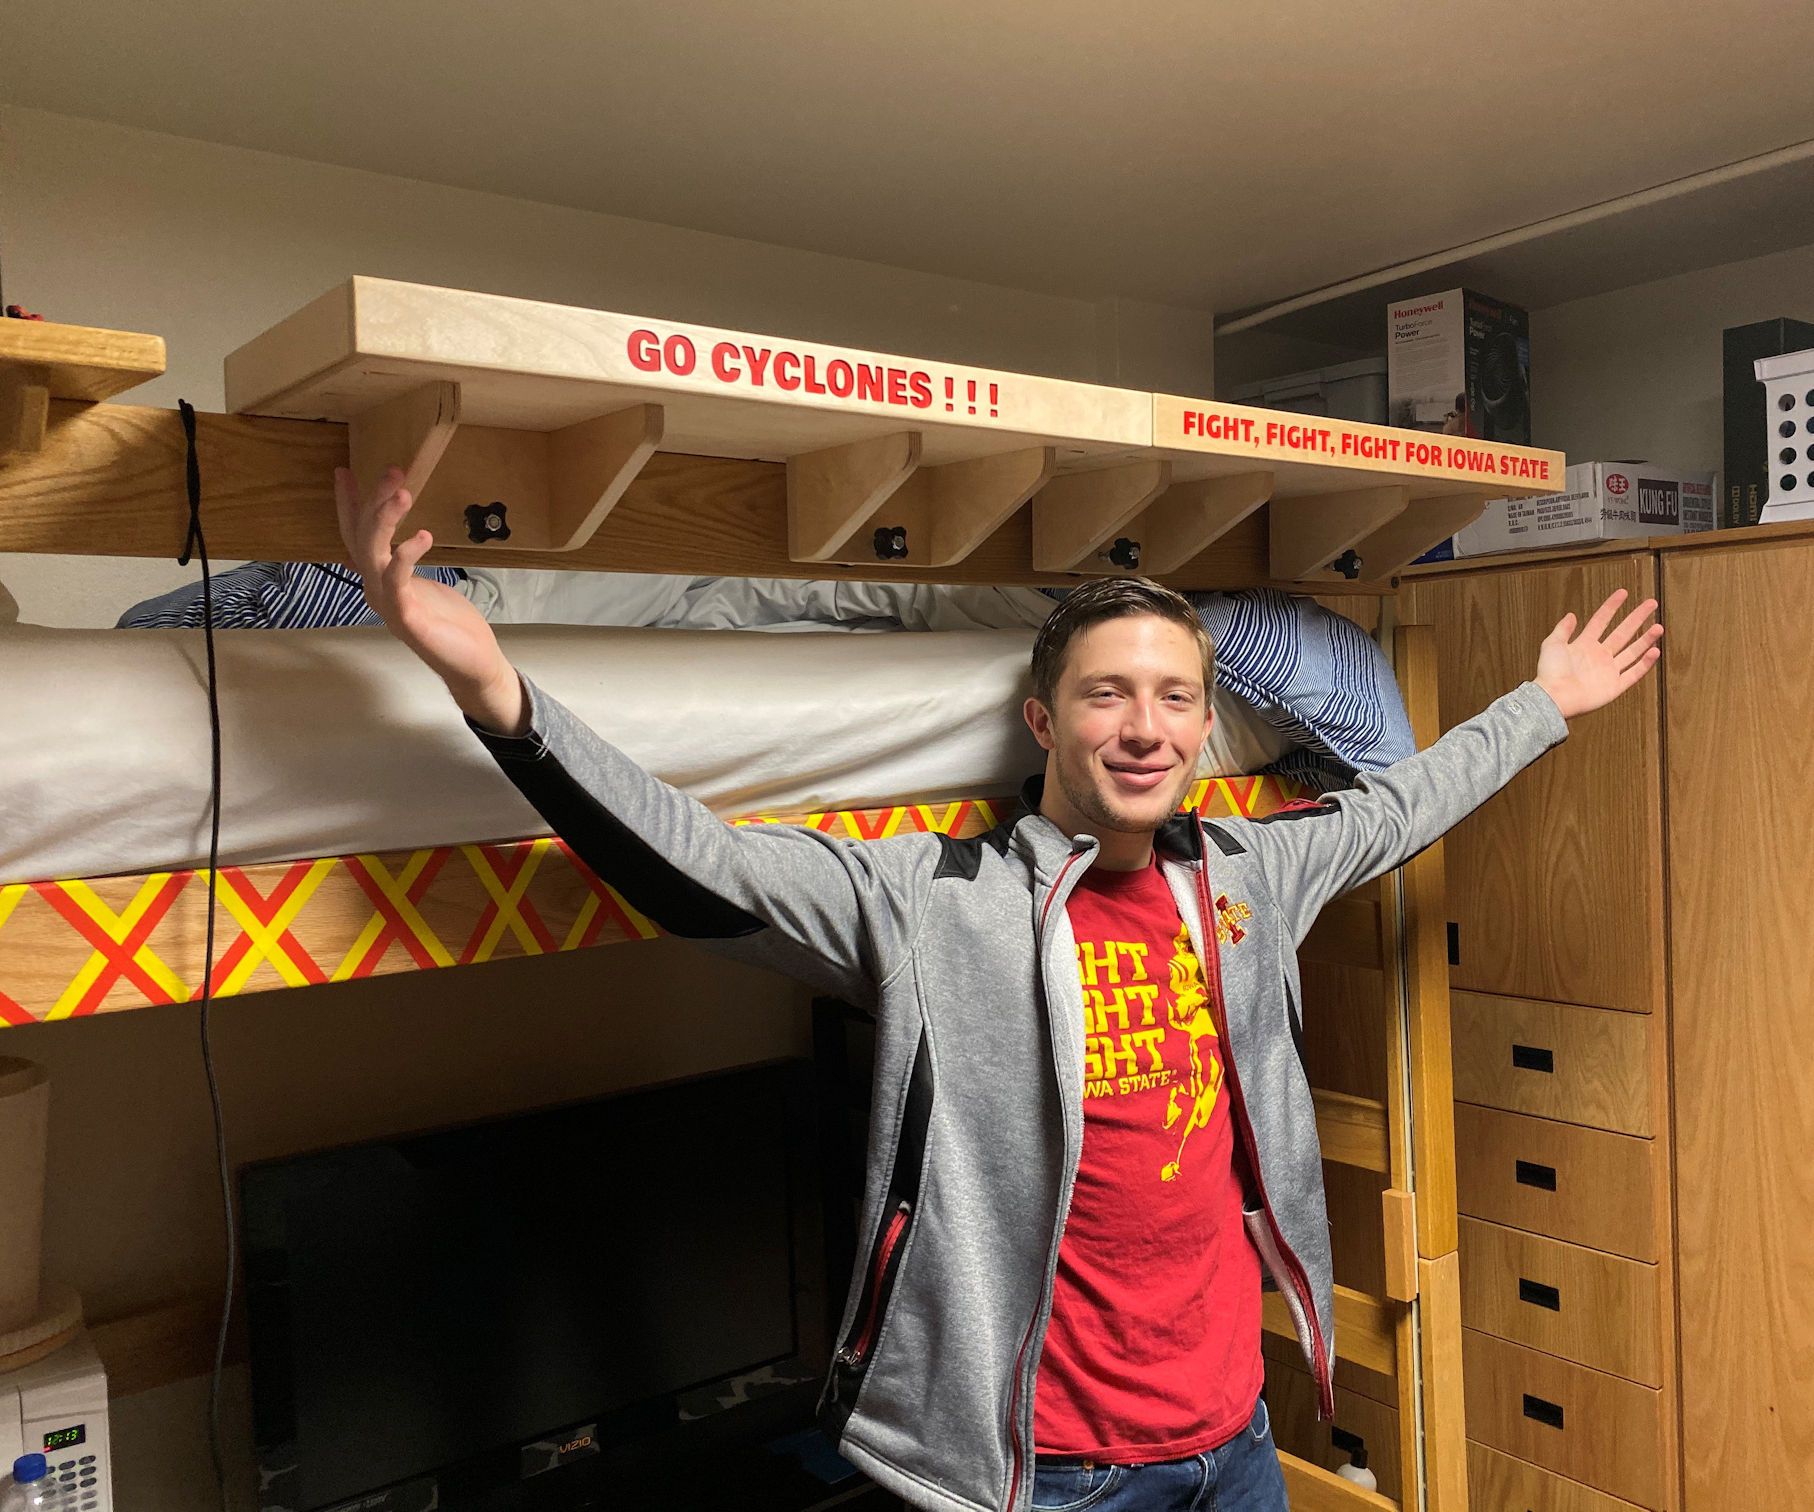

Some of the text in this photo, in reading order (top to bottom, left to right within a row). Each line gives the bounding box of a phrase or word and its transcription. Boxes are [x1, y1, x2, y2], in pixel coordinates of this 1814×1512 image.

[1393, 300, 1444, 319] Honeywell
[1395, 330, 1420, 340] Power
[627, 330, 696, 376] GO
[1183, 410, 1549, 481] FIGHT, FIGHT, FIGHT FOR IOWA STATE
[1639, 488, 1664, 515] KUNG
[1666, 490, 1678, 517] FU
[1118, 1069, 1172, 1096] STATE
[559, 1436, 592, 1454] VIZIO
